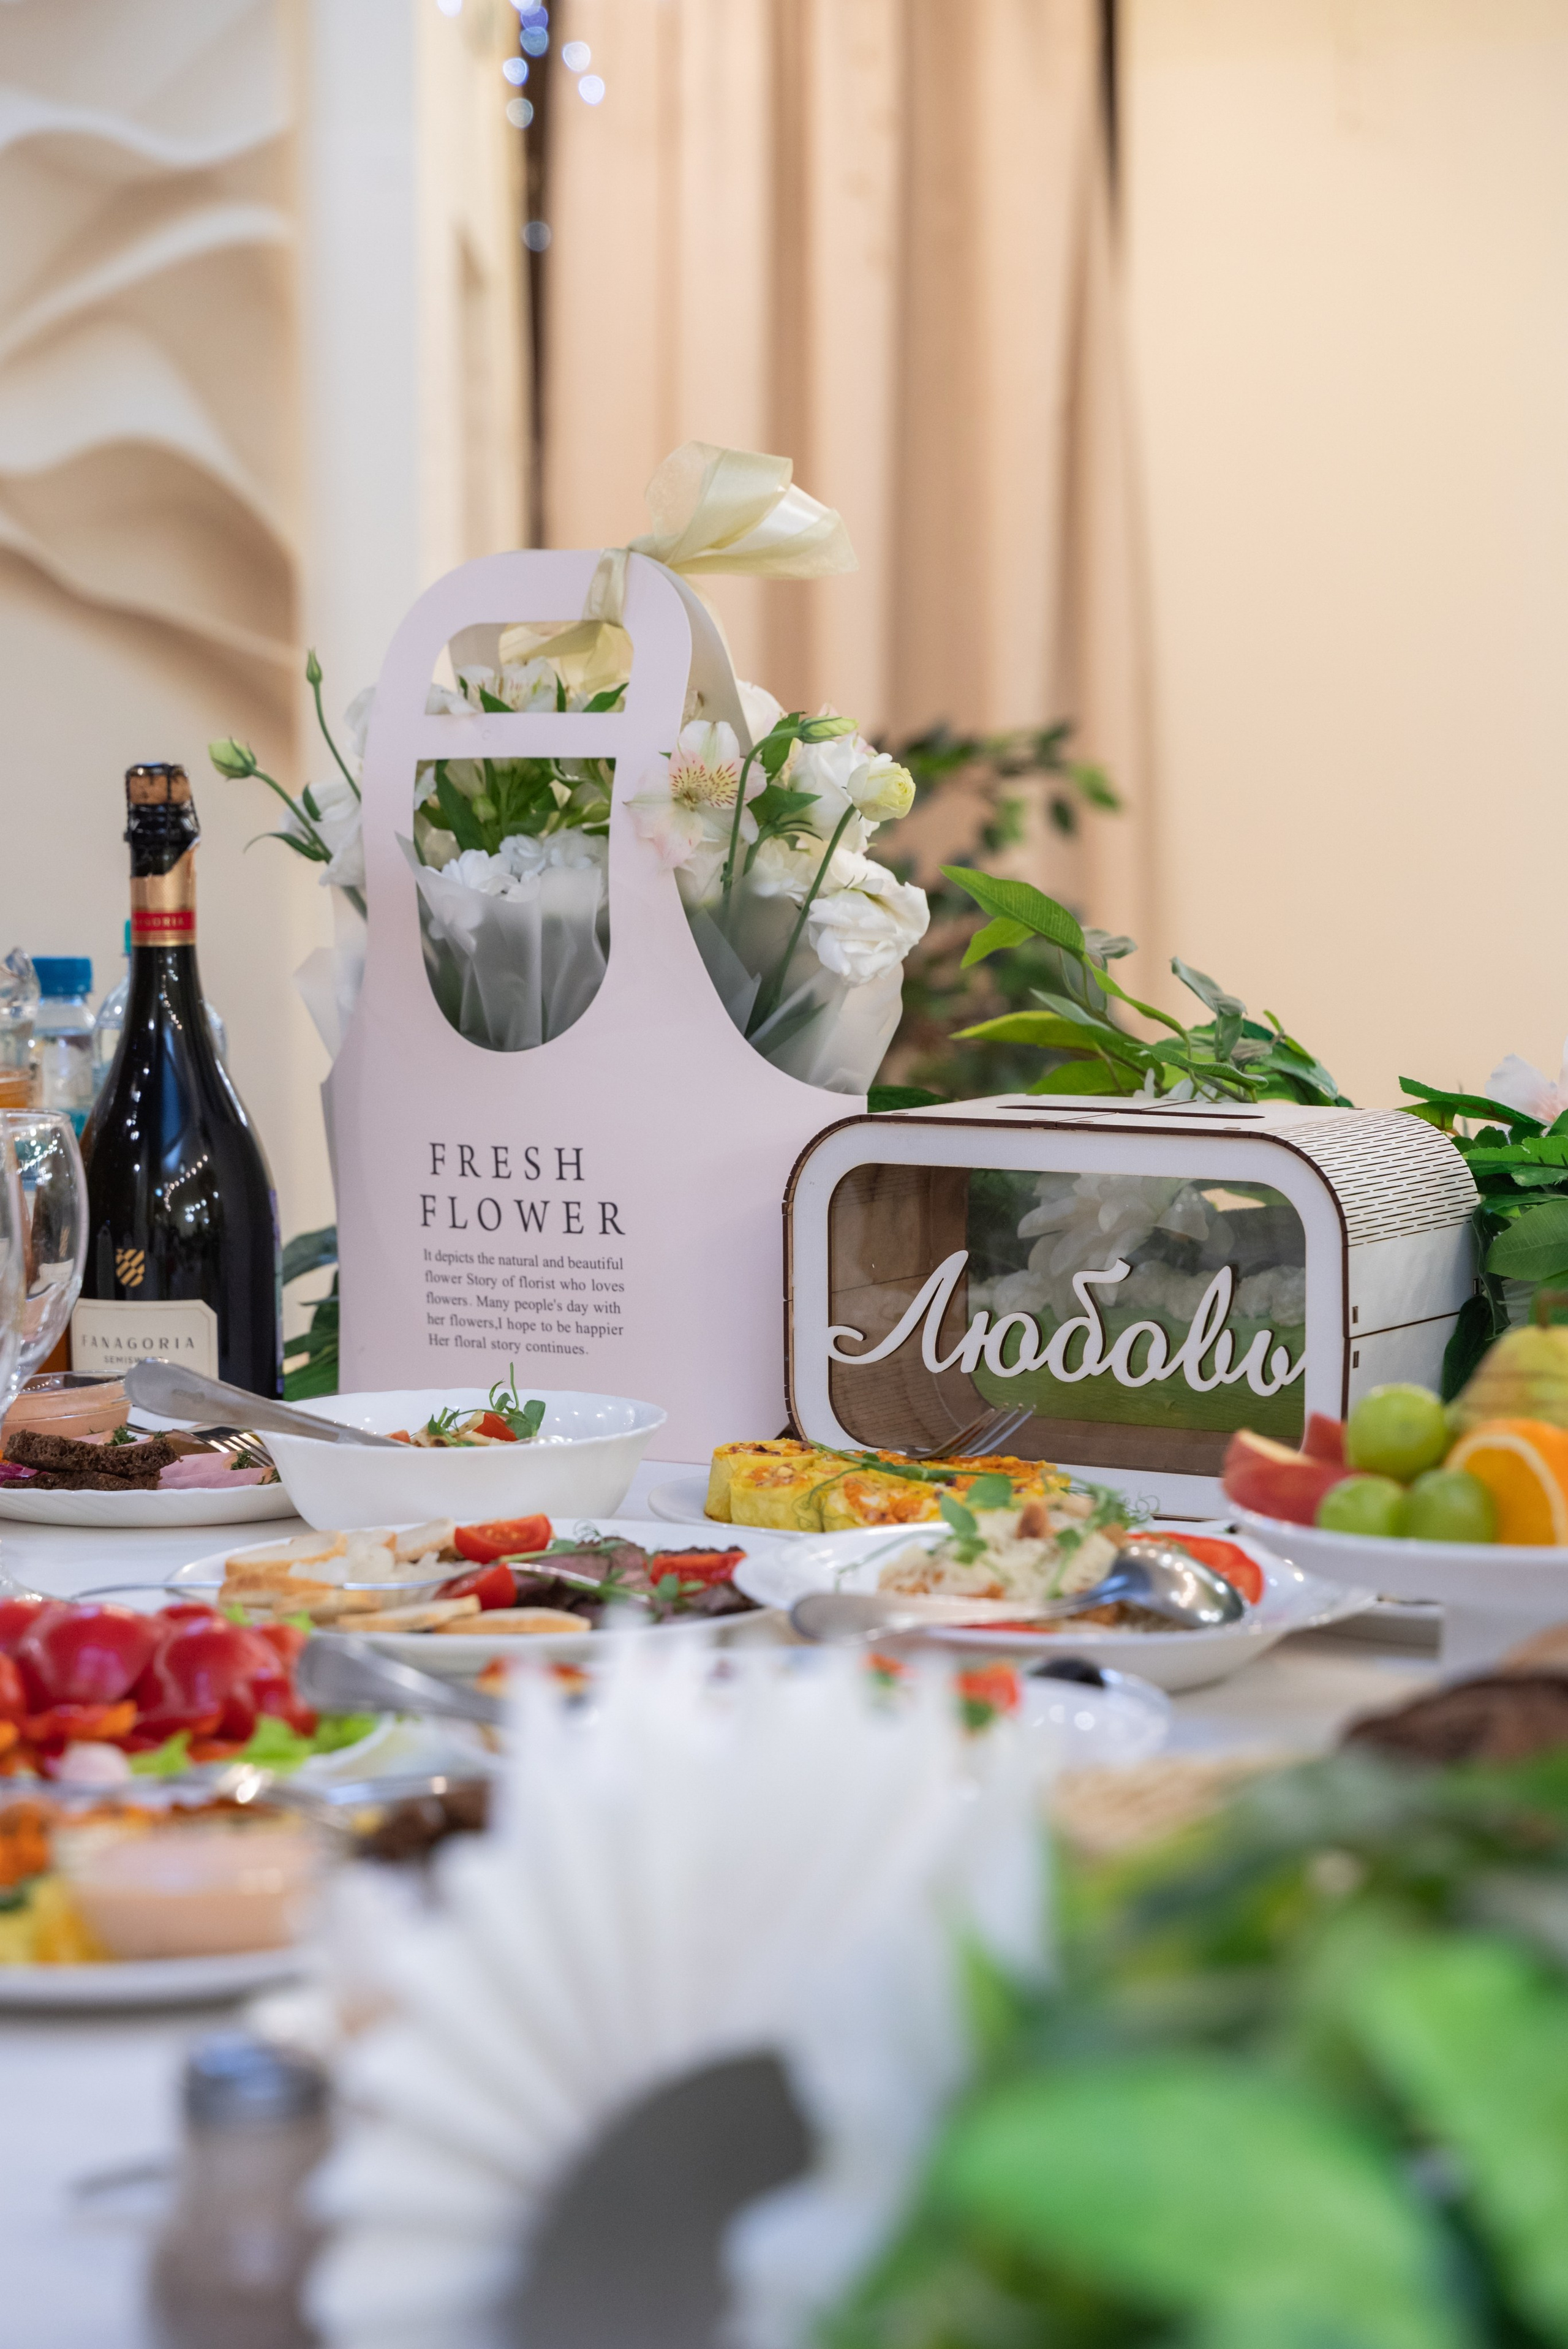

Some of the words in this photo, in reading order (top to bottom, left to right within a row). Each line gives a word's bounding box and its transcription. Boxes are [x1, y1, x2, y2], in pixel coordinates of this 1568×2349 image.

[430, 1142, 584, 1180] FRESH
[420, 1194, 625, 1235] FLOWER
[424, 1248, 431, 1261] It
[435, 1250, 474, 1265] depicts
[478, 1252, 495, 1265] the
[498, 1255, 538, 1267] natural
[543, 1256, 564, 1268] and
[568, 1256, 624, 1270] beautiful
[425, 1270, 462, 1284] flower
[467, 1273, 497, 1289] Story
[502, 1275, 516, 1287] of
[519, 1276, 556, 1289] florist
[560, 1278, 586, 1291] who
[591, 1279, 625, 1292] loves
[427, 1291, 472, 1306] flowers.
[477, 1295, 510, 1311] Many
[514, 1299, 563, 1313] people's
[567, 1300, 589, 1315] day
[594, 1301, 621, 1314] with
[427, 1312, 445, 1325] her
[507, 1318, 536, 1333] hope
[541, 1321, 552, 1332] to
[557, 1321, 571, 1333] be
[576, 1321, 624, 1338] happier
[827, 1250, 1307, 1396] Любовь
[81, 1334, 194, 1349] FANAGORIA
[429, 1333, 449, 1346] Her
[454, 1335, 486, 1348] floral
[491, 1340, 521, 1354] story
[526, 1341, 589, 1355] continues.
